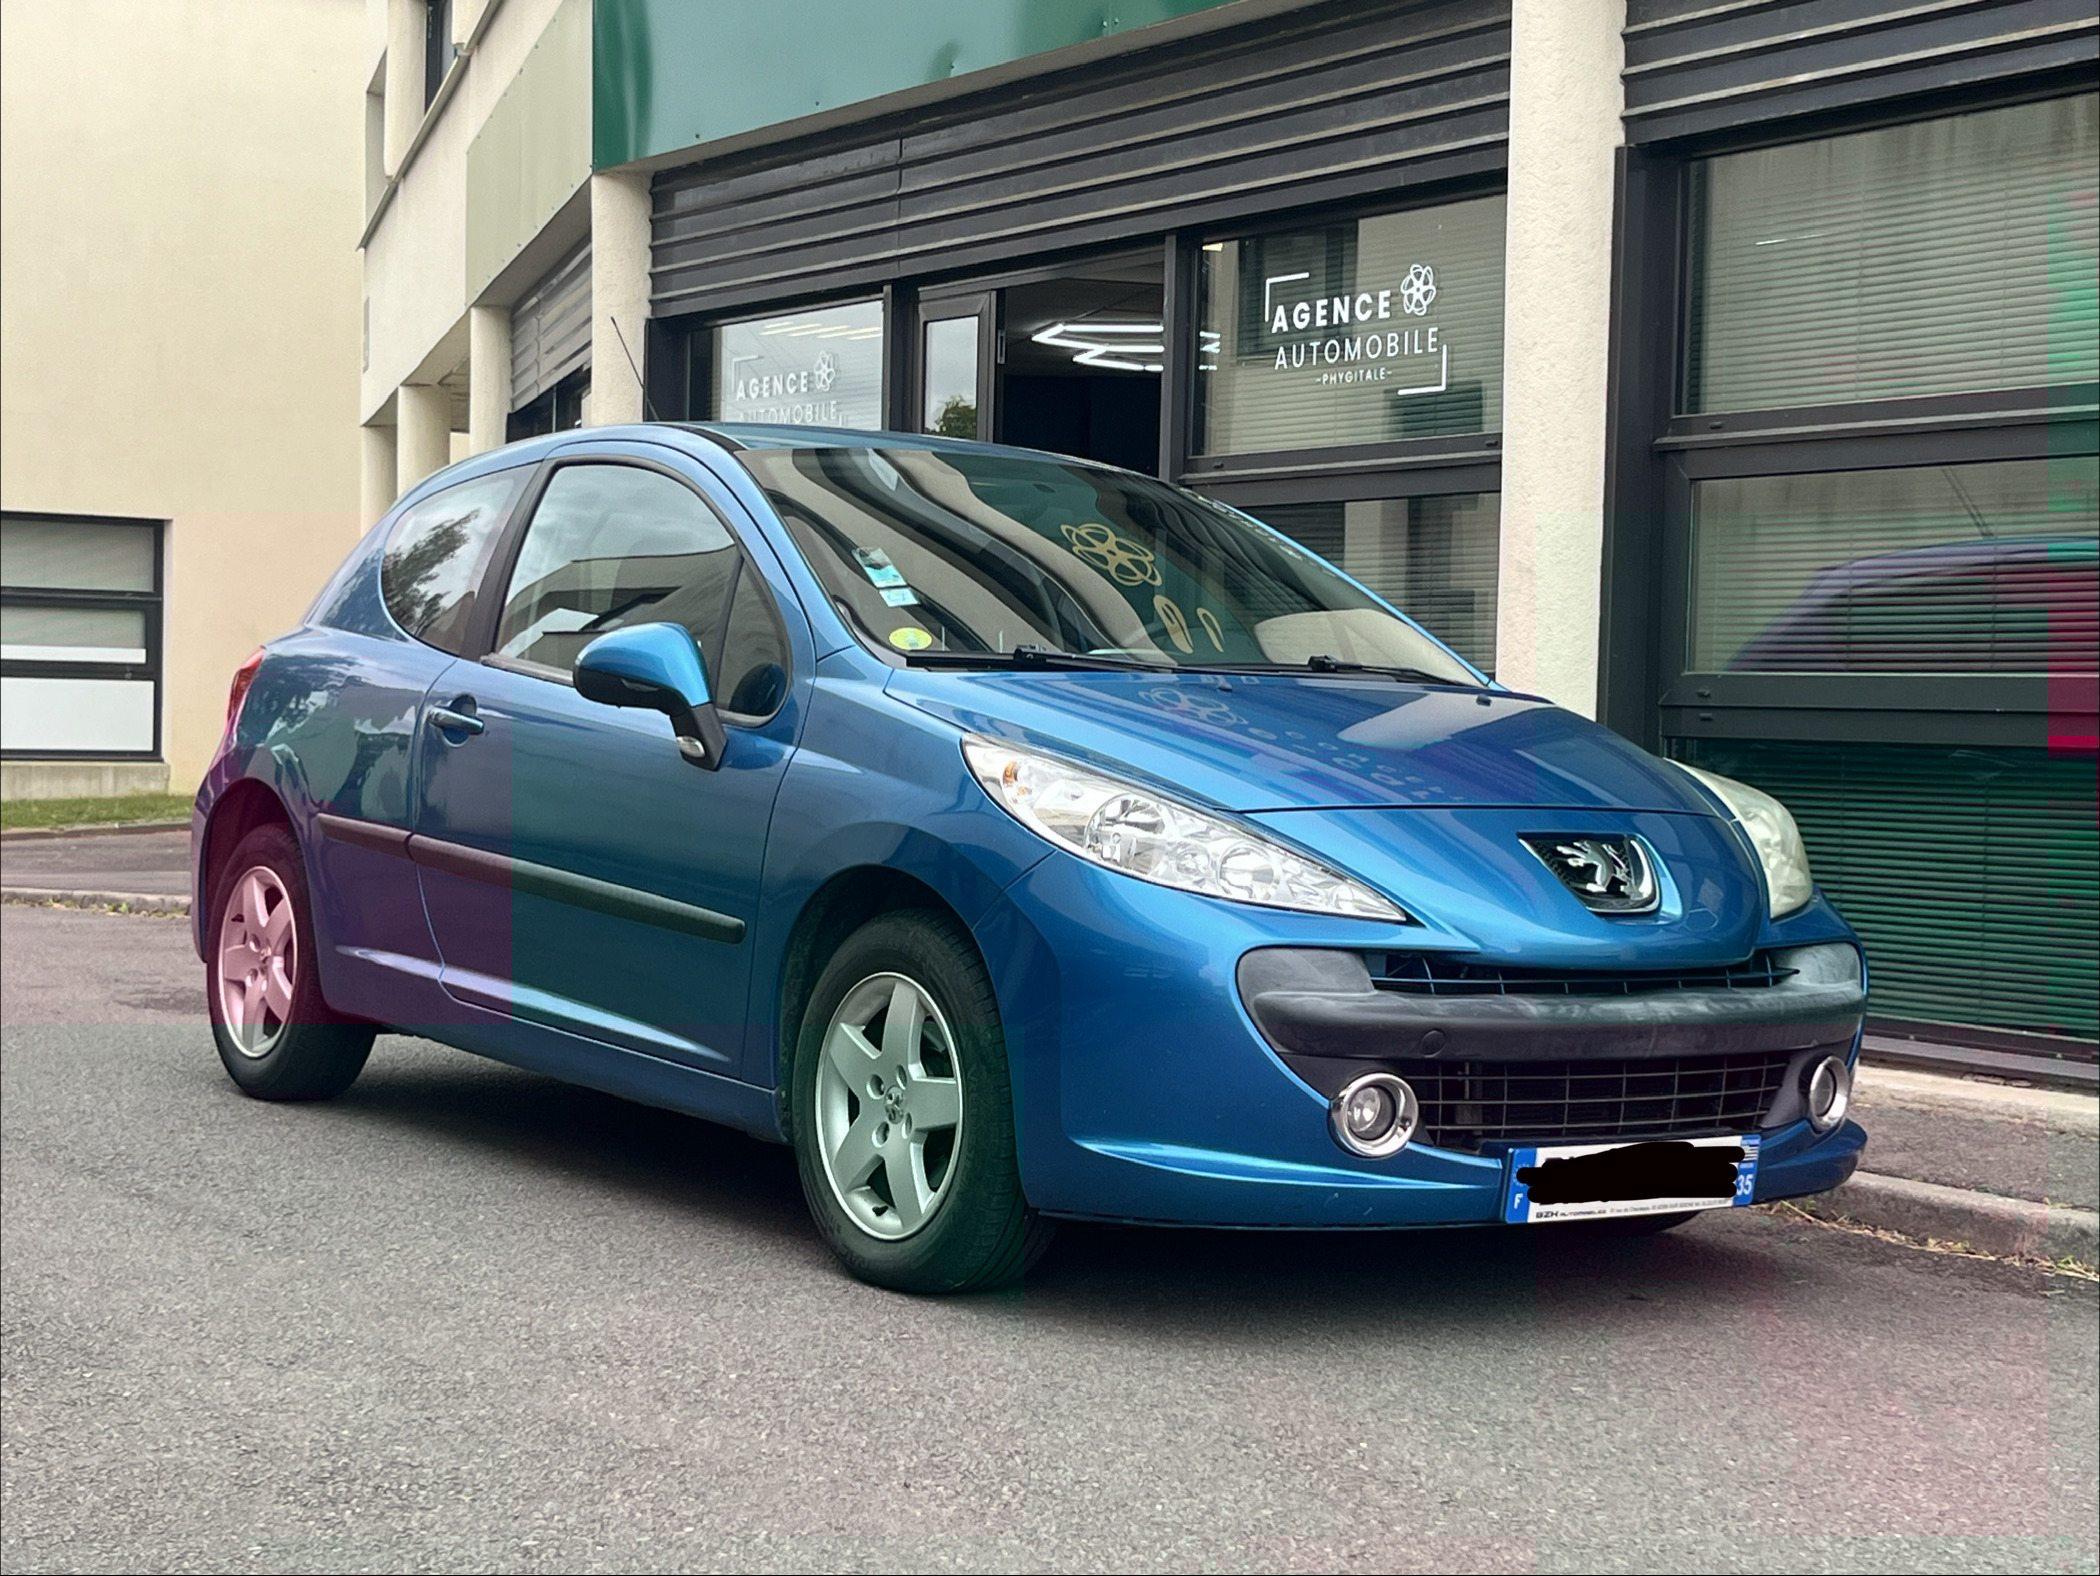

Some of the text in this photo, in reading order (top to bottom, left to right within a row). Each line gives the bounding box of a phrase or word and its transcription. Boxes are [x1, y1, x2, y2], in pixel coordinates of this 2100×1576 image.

[1271, 289, 1391, 334] AGENCE
[1274, 327, 1439, 371] AUTOMOBILE
[736, 371, 809, 401] AGENCE
[1736, 1174, 1754, 1196] 35
[1513, 1193, 1524, 1209] F
